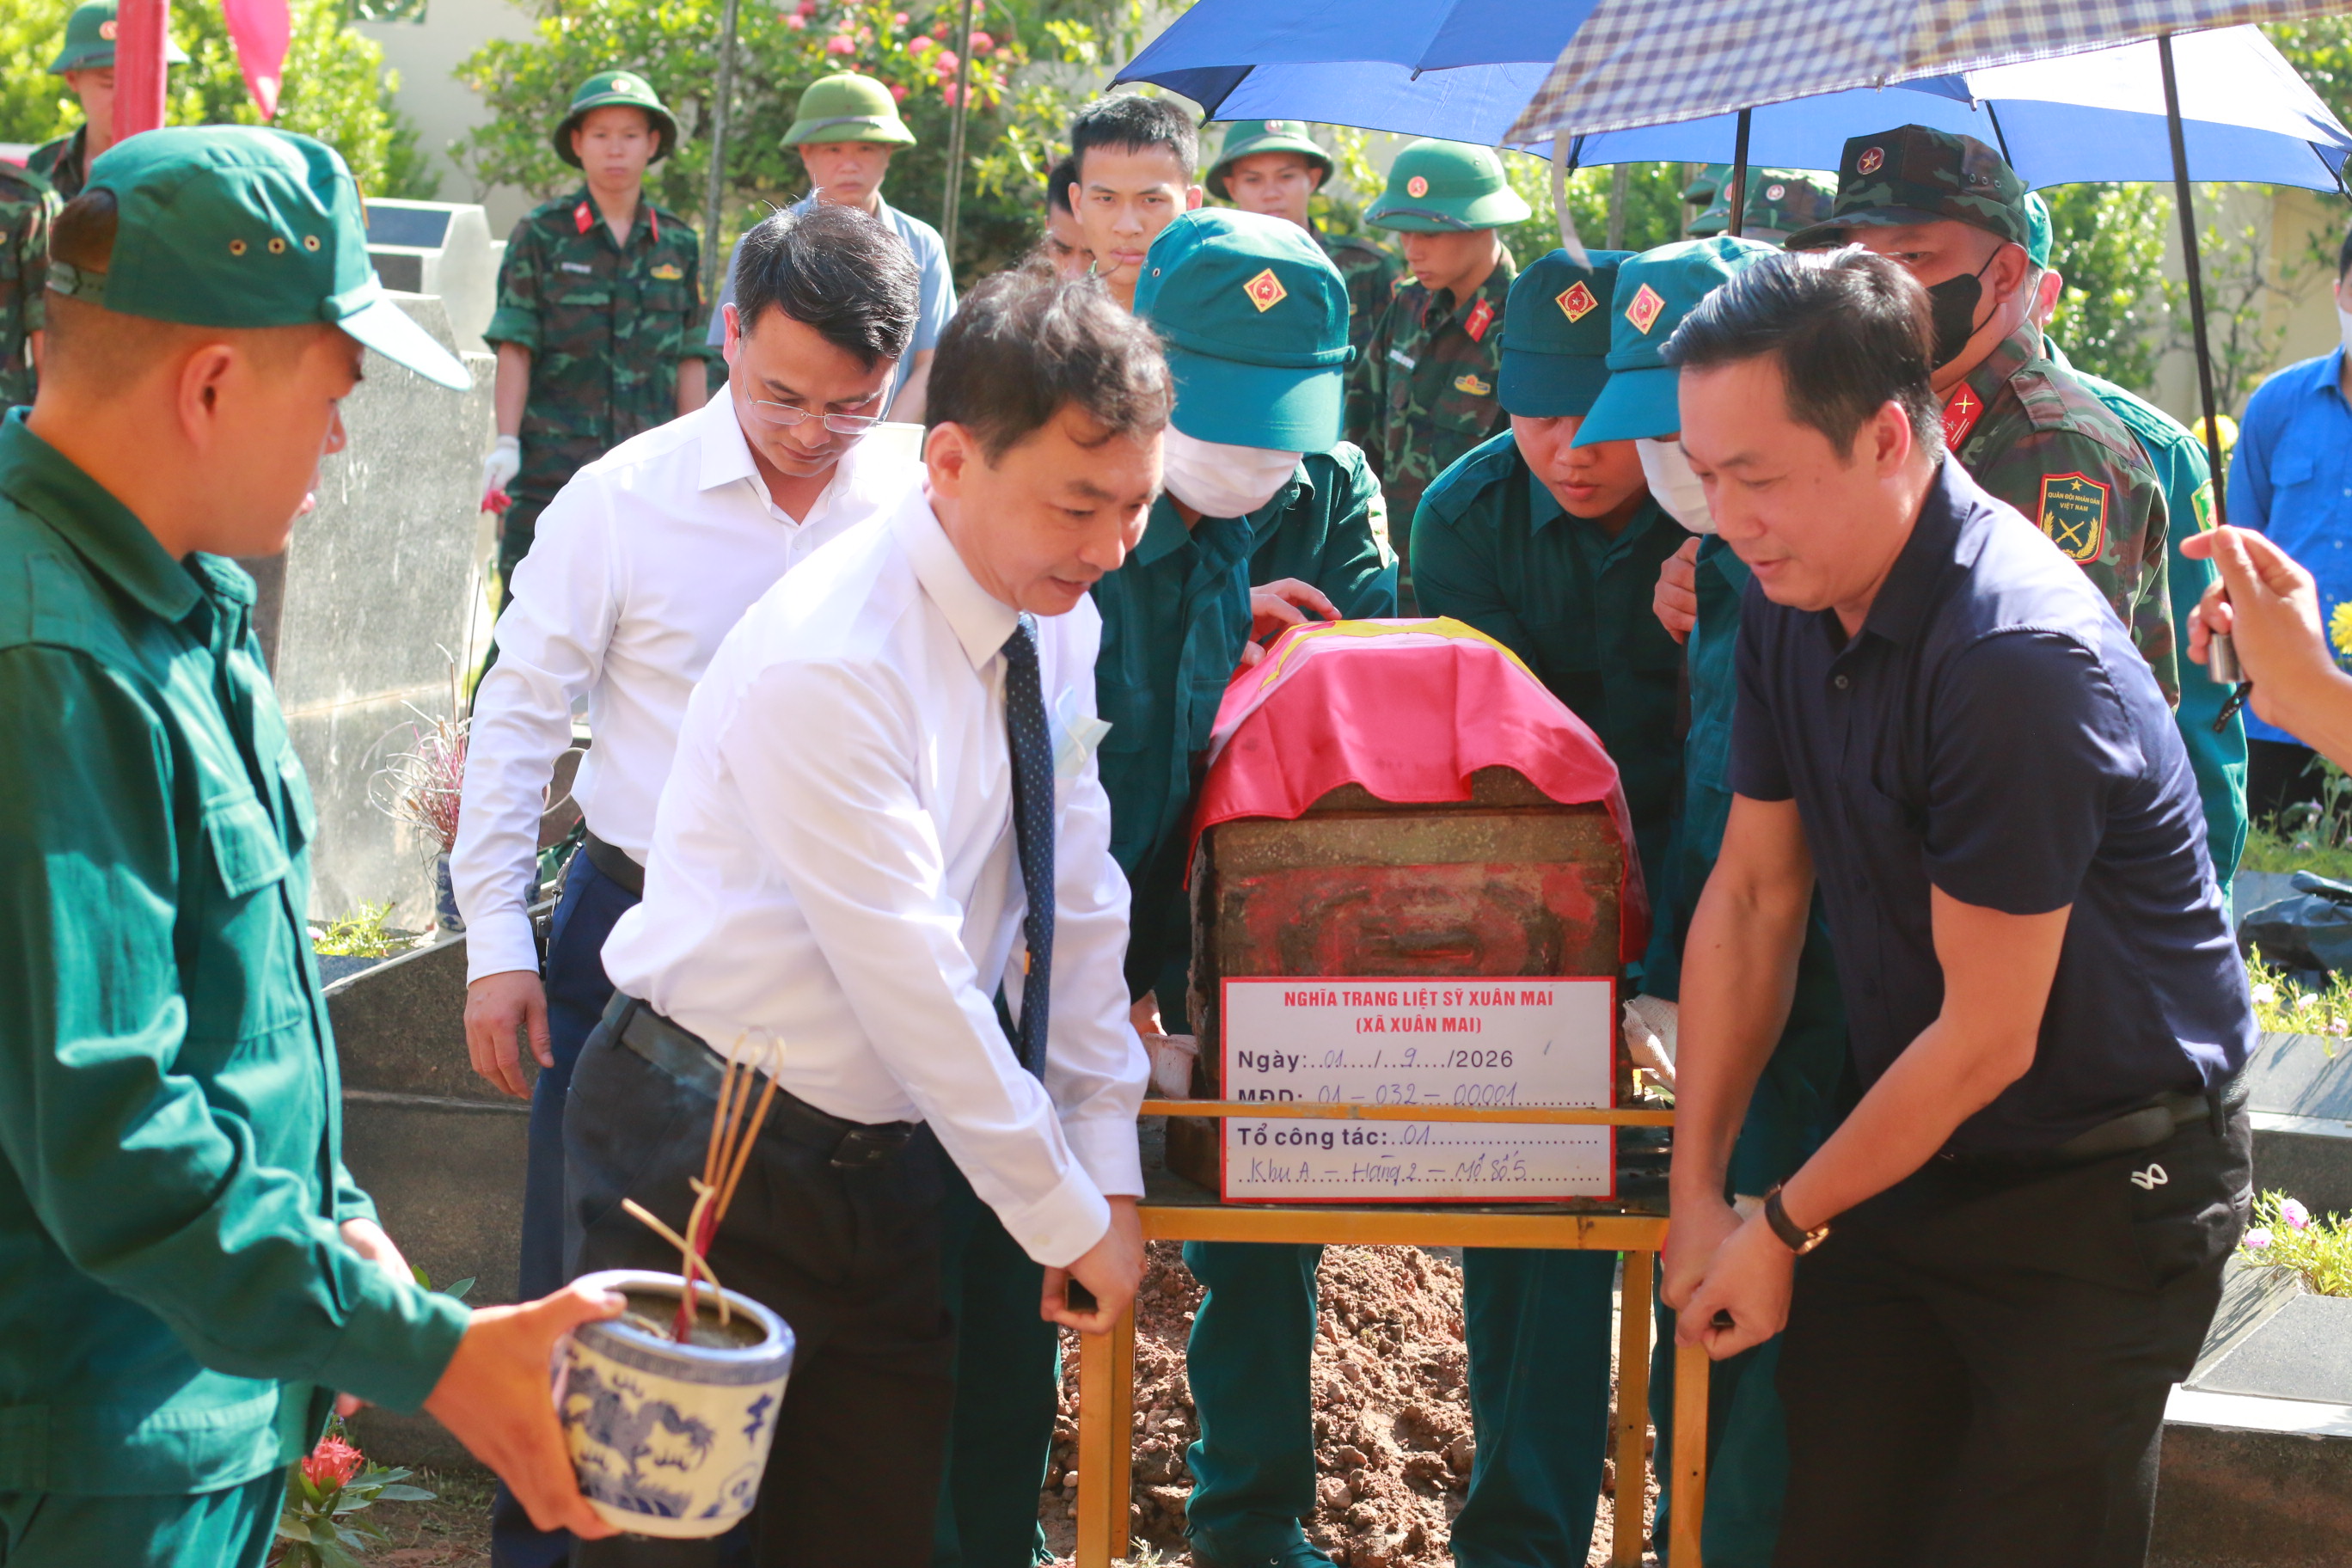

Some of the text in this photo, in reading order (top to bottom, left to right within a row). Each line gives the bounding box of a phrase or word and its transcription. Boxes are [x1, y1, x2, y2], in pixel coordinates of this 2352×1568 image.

[2060, 502, 2073, 511] VIỆT
[1284, 989, 1553, 1009] NGHĨA TRANG LIỆT SỸ XUÂN MAI
[1356, 1014, 1481, 1034] (XÃ XUÂN MAI)
[1238, 1123, 1267, 1146] Tổ
[1275, 1127, 1334, 1150] công
[1342, 1127, 1387, 1146] tác:
